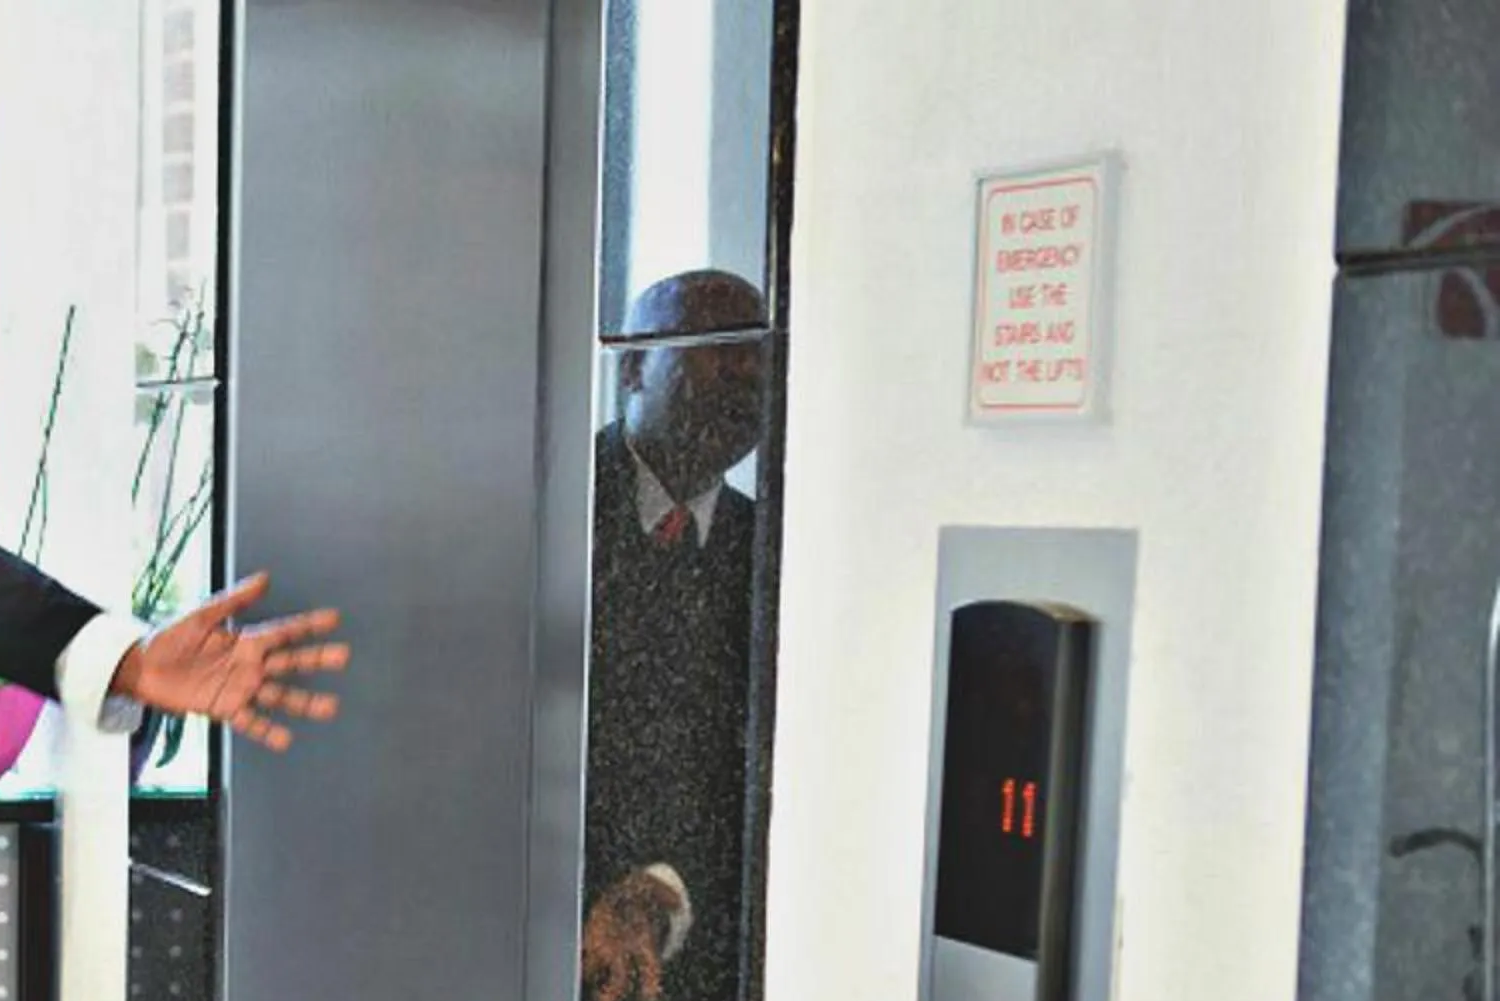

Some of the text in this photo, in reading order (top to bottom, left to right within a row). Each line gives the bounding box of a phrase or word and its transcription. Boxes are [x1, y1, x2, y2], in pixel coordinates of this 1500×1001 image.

[1060, 204, 1081, 229] OF
[1008, 283, 1067, 309] USE THE
[1017, 359, 1042, 382] THE
[1002, 777, 1037, 838] 11
